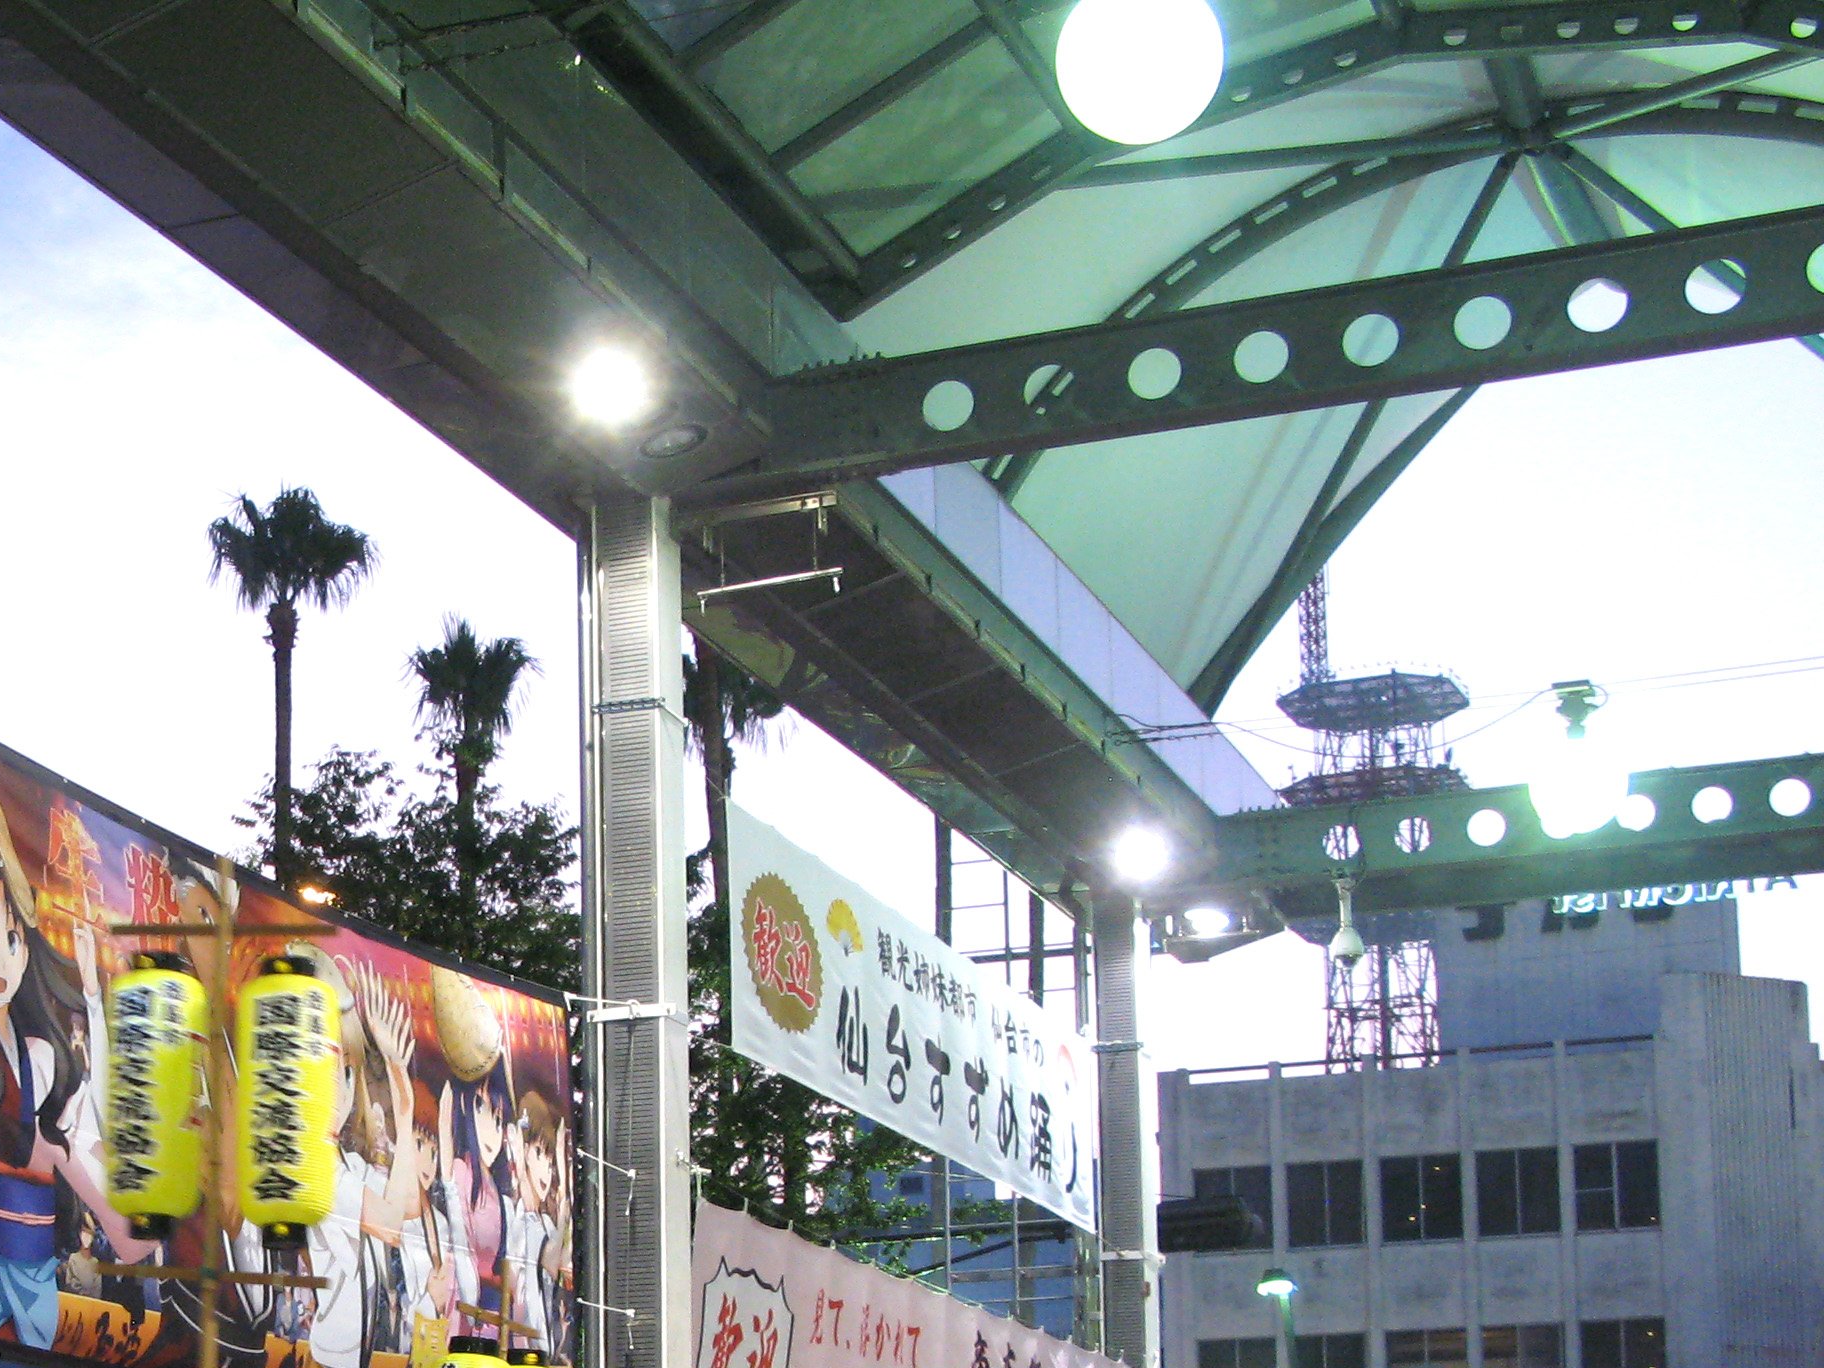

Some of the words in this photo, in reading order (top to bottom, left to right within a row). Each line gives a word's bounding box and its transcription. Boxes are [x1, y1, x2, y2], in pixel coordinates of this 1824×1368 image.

[752, 897, 817, 1010] 歓迎
[876, 927, 977, 1030] 観光姉妹都市
[836, 985, 1078, 1193] 仙台すずめ踊り
